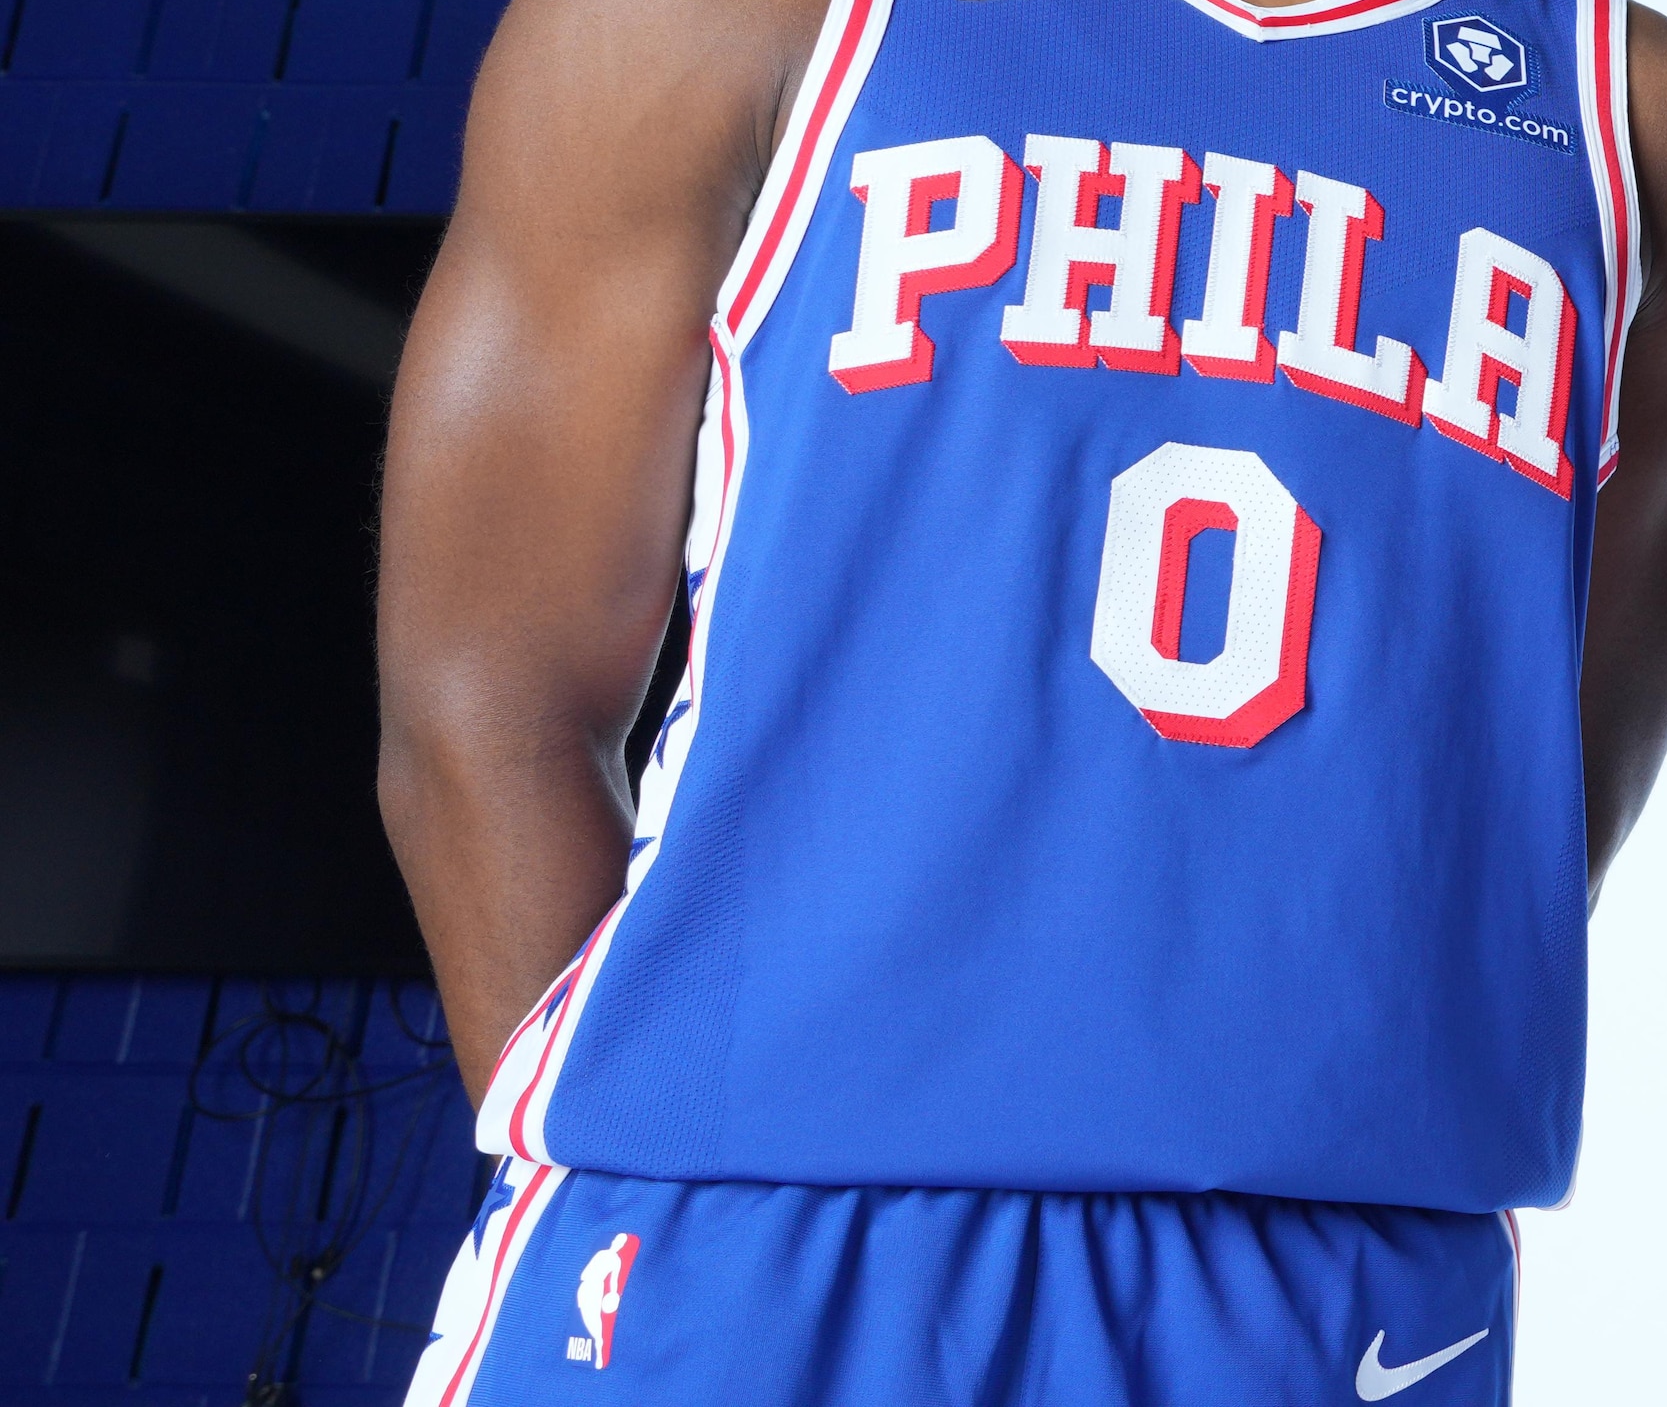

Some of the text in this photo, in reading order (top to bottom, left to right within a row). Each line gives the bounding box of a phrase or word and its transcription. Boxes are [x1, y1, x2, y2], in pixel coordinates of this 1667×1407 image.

[1391, 87, 1570, 147] crypto.com
[828, 134, 1578, 502] PHILA
[1090, 441, 1323, 749] 0
[566, 1336, 593, 1362] NBA
